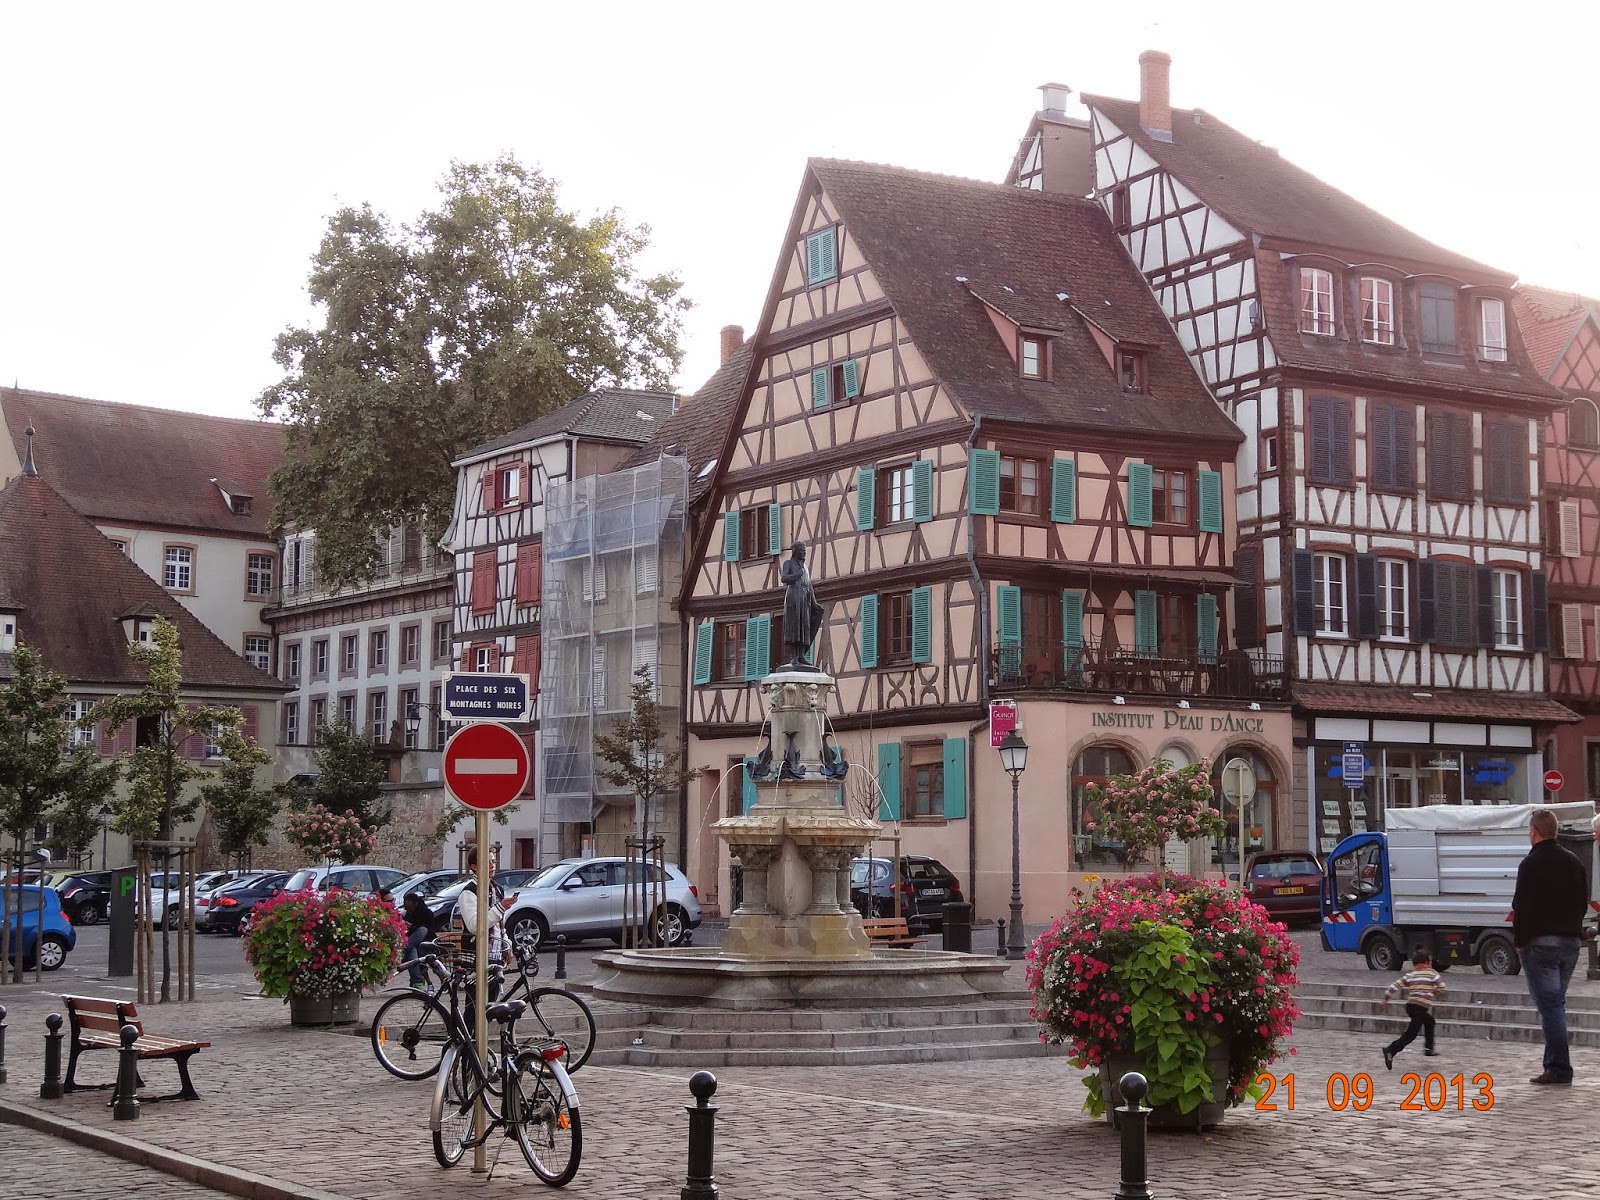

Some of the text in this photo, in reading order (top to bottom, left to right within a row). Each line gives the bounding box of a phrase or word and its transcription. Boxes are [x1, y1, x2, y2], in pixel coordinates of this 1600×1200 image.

[455, 685, 516, 694] PLACE DES SIX
[449, 700, 522, 710] MONTAGNES NOIRES
[1092, 710, 1264, 732] INSTITUT PEAU D'ANGE
[121, 876, 135, 897] P
